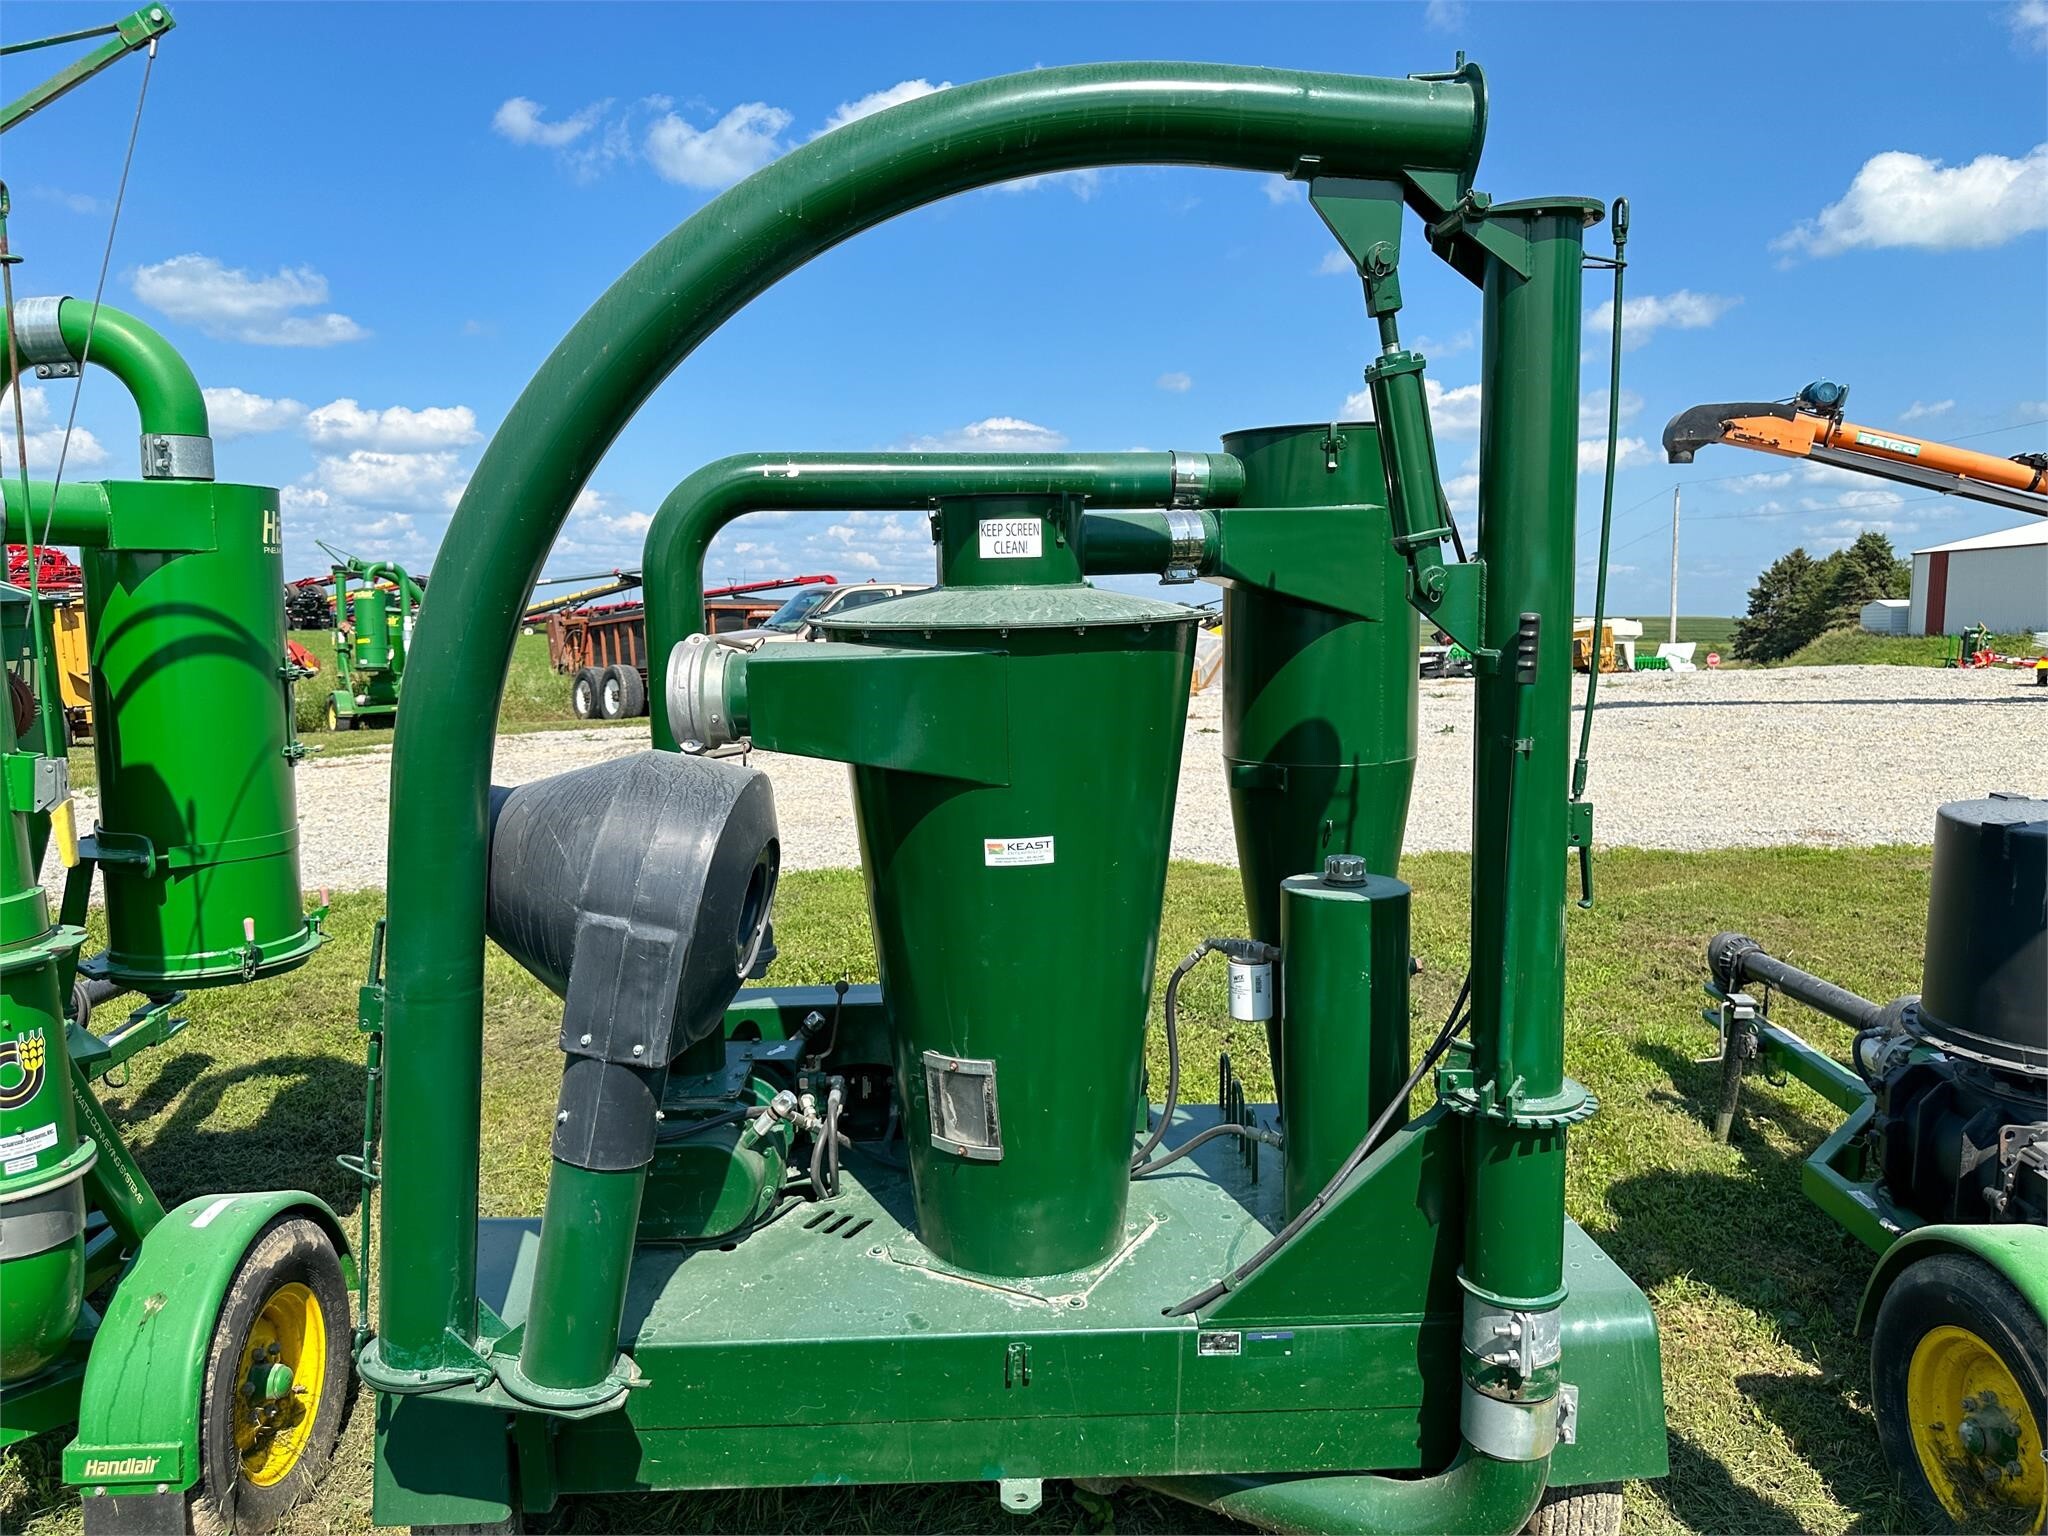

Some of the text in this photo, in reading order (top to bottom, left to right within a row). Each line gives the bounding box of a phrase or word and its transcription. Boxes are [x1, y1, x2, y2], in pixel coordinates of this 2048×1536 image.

[980, 522, 1040, 537] KEEP SCREEN
[993, 540, 1028, 555] CLEAN!
[1007, 840, 1052, 851] KEAST
[90, 1115, 122, 1167] CONVEYING
[119, 1163, 144, 1205] SYSTEMS
[84, 1455, 162, 1476] Handlair
